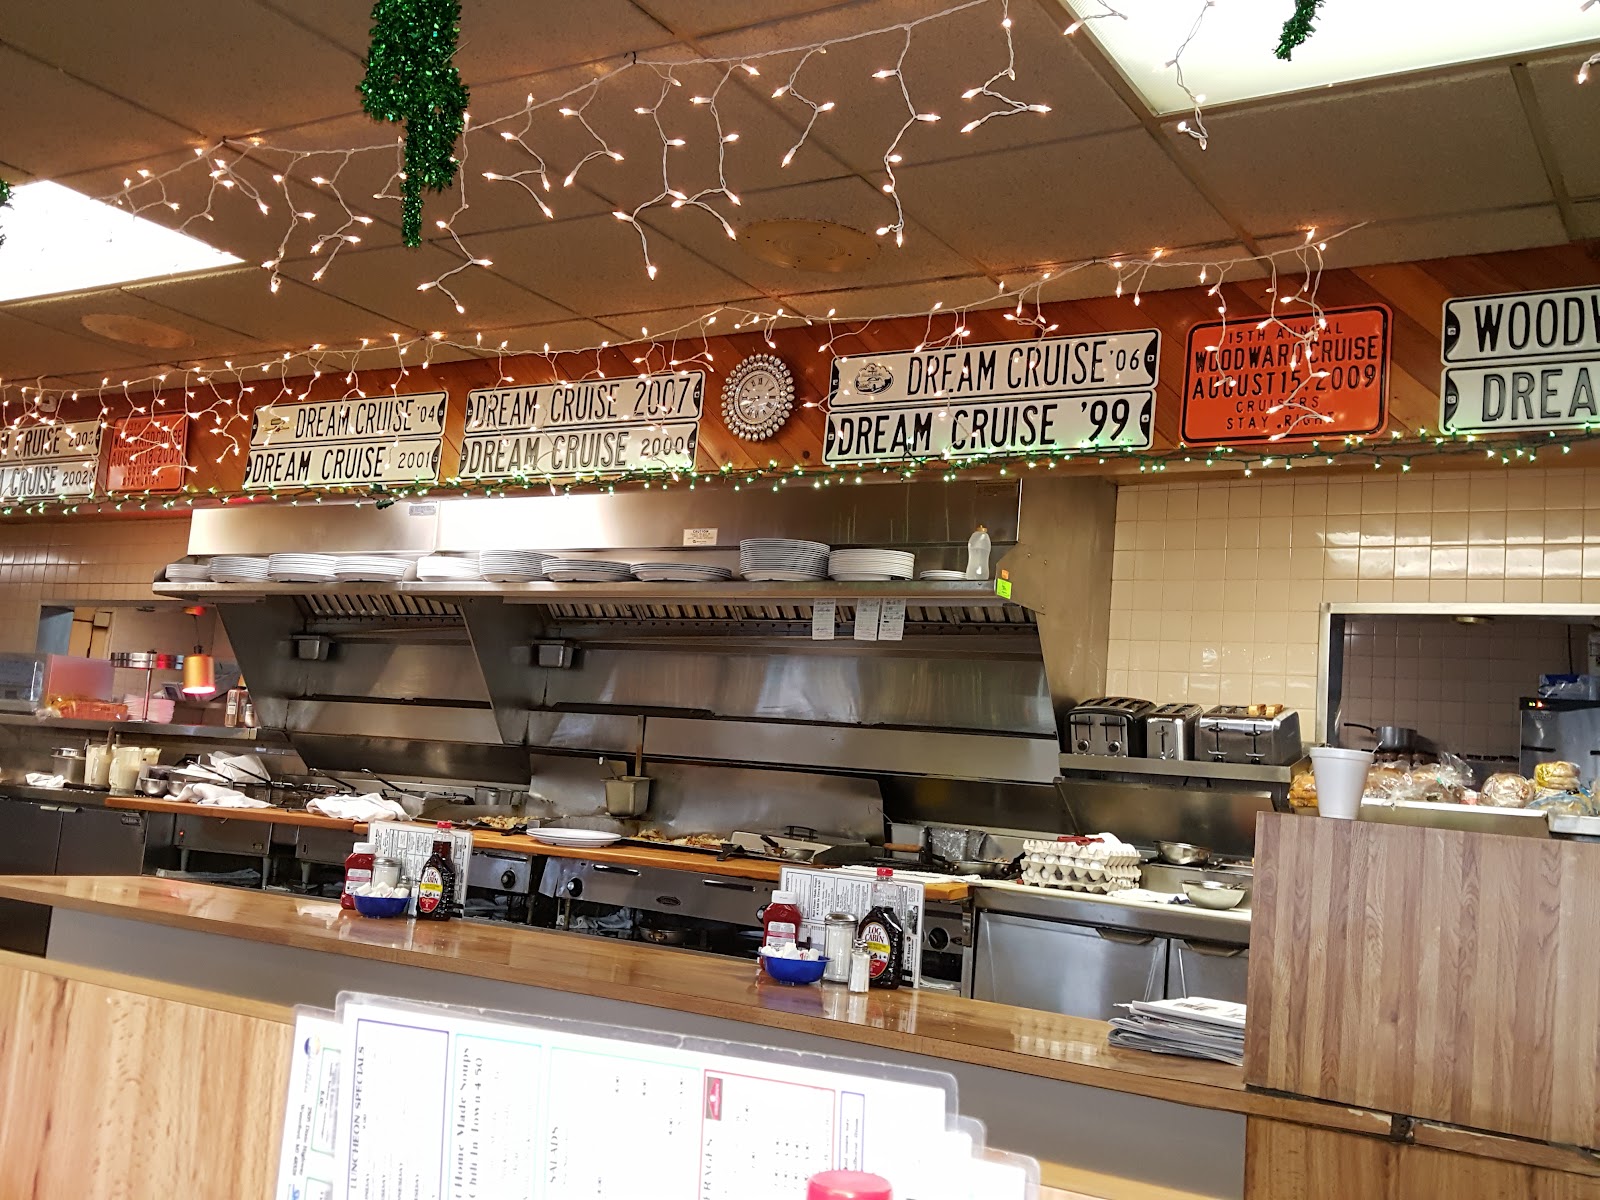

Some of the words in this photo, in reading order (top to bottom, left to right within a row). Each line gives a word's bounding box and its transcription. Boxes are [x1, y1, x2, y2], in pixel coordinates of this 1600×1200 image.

[1229, 331, 1266, 344] 15TH
[1309, 335, 1379, 364] CRUISE
[906, 350, 997, 395] DREAM
[1007, 341, 1108, 388] CRUISE
[474, 390, 538, 428] DREAM
[550, 384, 620, 424] CRUISE
[633, 378, 691, 417] 2007
[1236, 396, 1320, 413] CRUISERS
[295, 405, 350, 439] DREAM
[355, 399, 415, 435] CRUISE
[837, 412, 933, 456] DREAM
[951, 403, 1059, 450] CRUISE
[1081, 398, 1130, 443] '99
[1227, 416, 1269, 430] STAY
[15, 427, 63, 457] CRUISE
[469, 436, 541, 474] DREAM
[551, 432, 630, 470] CRUISE
[640, 436, 684, 457] 2000
[9, 465, 58, 496] CRUISE
[62, 470, 90, 487] 2002
[252, 449, 312, 484] DREAM
[321, 446, 387, 481] CRUISE
[397, 451, 431, 469] 2001
[864, 933, 884, 944] CABIN
[868, 926, 882, 936] LOG
[354, 1046, 365, 1110] SPECIALS
